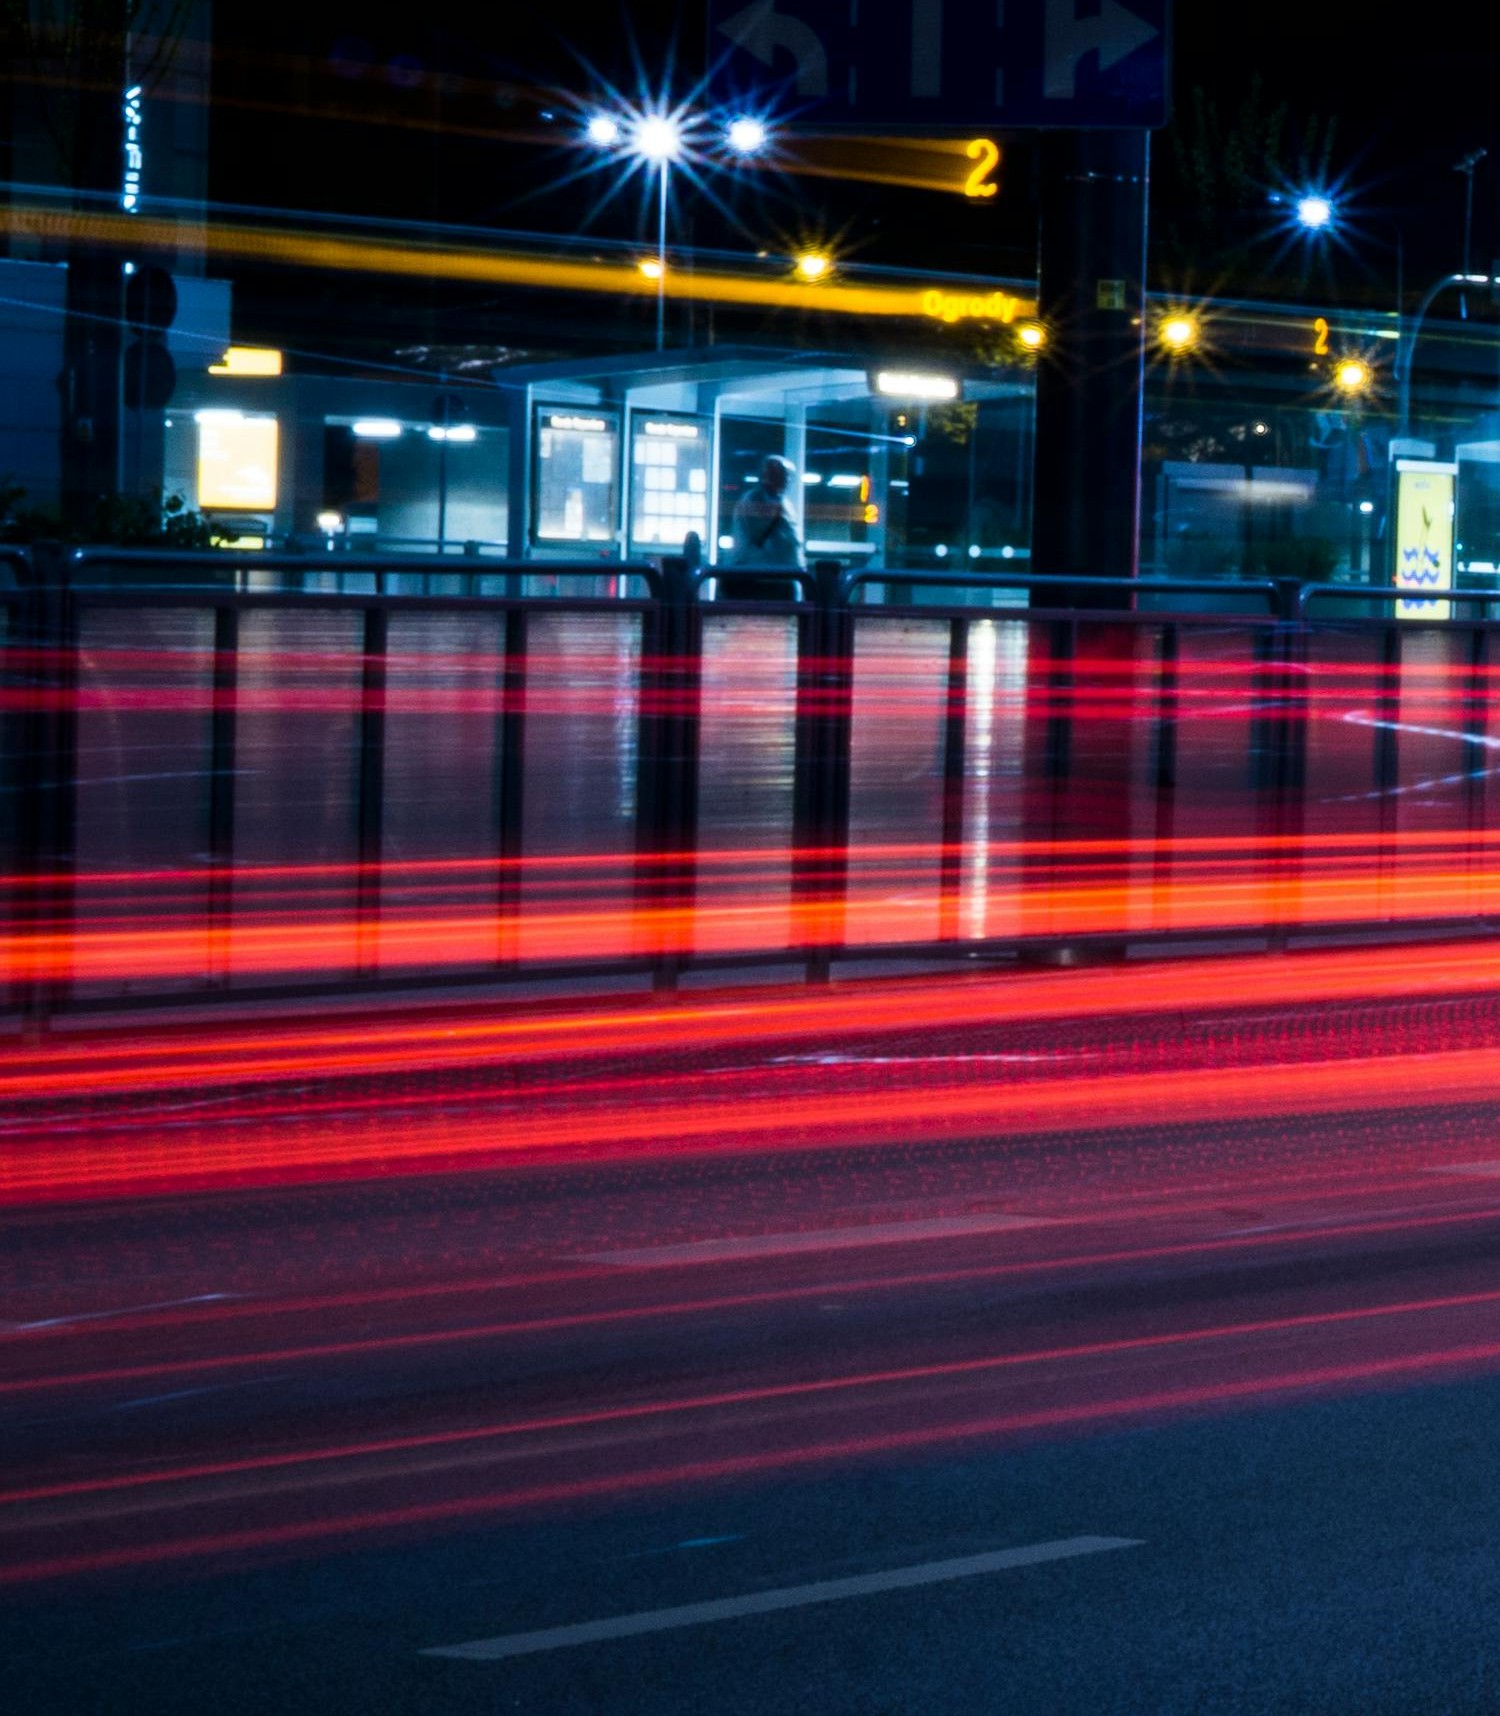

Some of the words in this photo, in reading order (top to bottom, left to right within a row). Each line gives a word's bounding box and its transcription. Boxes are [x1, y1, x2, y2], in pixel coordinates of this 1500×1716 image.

[965, 138, 999, 197] 2
[922, 290, 1018, 323] Ogrody
[1314, 317, 1329, 355] 2
